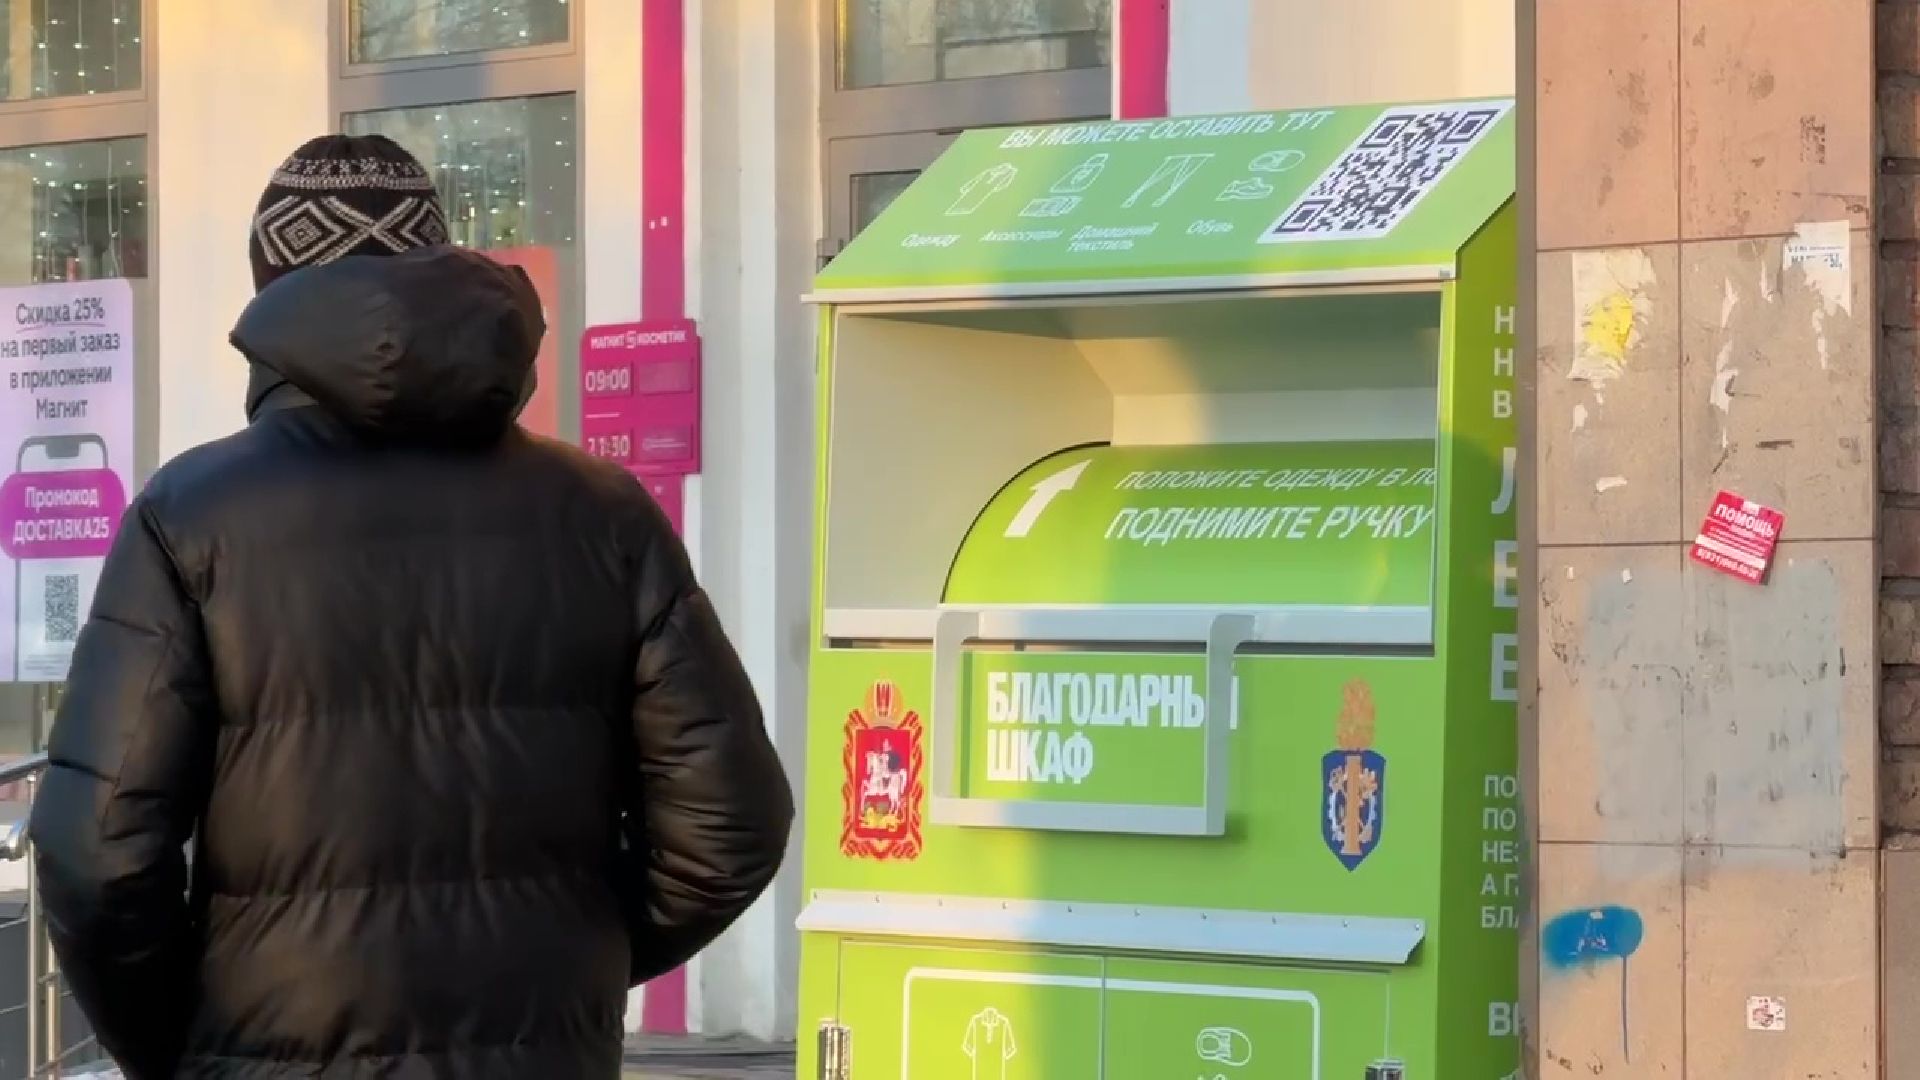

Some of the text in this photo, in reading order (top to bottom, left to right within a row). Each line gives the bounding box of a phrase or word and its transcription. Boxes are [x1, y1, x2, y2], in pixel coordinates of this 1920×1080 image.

[1000, 110, 1335, 149] ВЫ МОЖЕТЕ ОСТАВИТЬ ТУТ
[1069, 221, 1159, 241] Домашний
[1185, 219, 1234, 235] Обувь
[16, 297, 105, 325] Скидка 25%
[0, 331, 121, 360] на первый заказ
[10, 366, 112, 393] в приложении
[585, 368, 630, 392] 09:00
[36, 399, 88, 419] Магнит
[1492, 389, 1512, 418] В
[1114, 469, 1270, 490] ПОЛОЖИТЕ
[1263, 468, 1386, 491] ОДЕЖДУ
[1376, 468, 1408, 487] В
[25, 486, 99, 513] Промокод
[13, 516, 110, 544] ДОСТАВКА25
[1104, 504, 1435, 546] ПОДНИМИТЕ РУЧКУ
[1714, 503, 1775, 537] ПОМОЩЬ
[987, 671, 1239, 730] БЛАГОДАРНЫ
[987, 728, 1094, 784] ШКАФ
[1480, 873, 1498, 895] А
